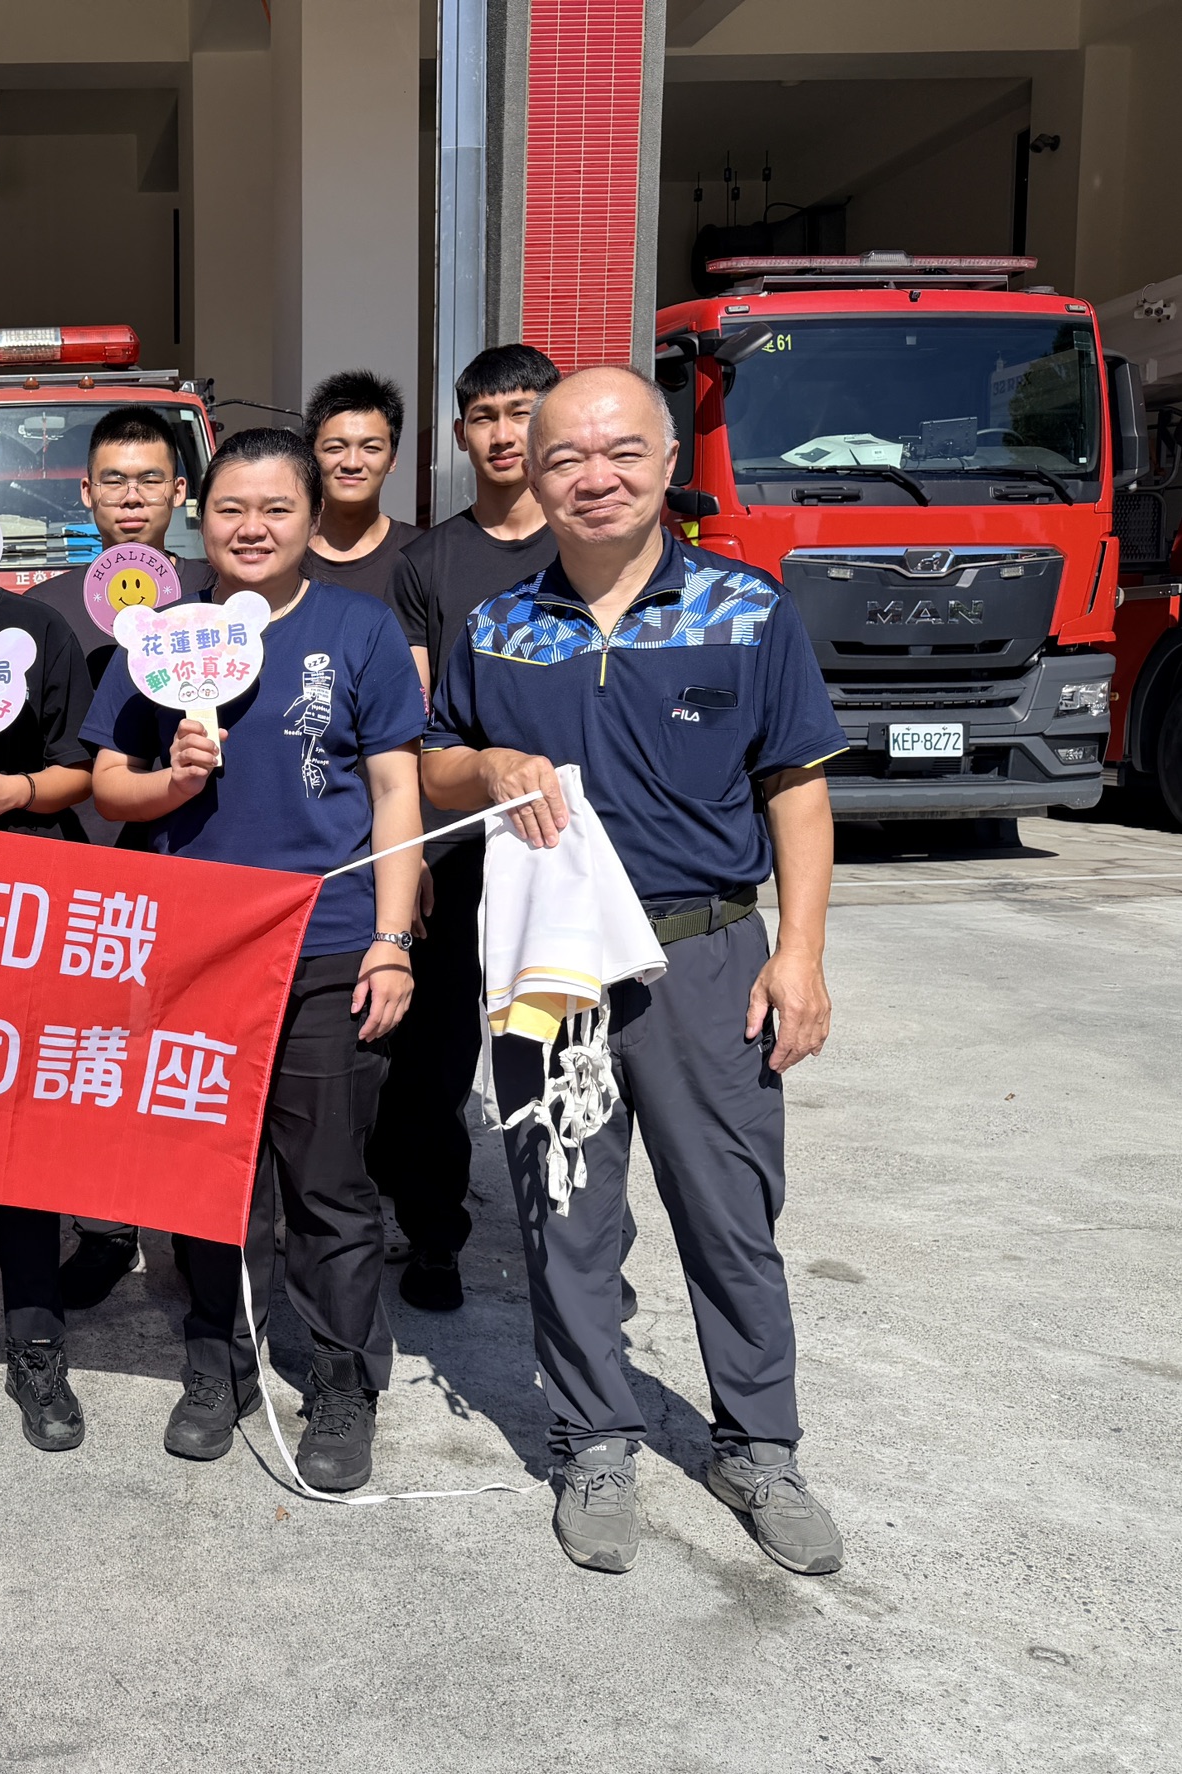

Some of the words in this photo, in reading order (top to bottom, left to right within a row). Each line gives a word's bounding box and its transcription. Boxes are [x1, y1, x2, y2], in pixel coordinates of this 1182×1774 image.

[92, 551, 168, 581] HUALIEN
[866, 600, 984, 624] MAN
[141, 622, 248, 657] 花蓮郵局
[144, 656, 251, 693] 郵你真好
[671, 708, 700, 722] FILA
